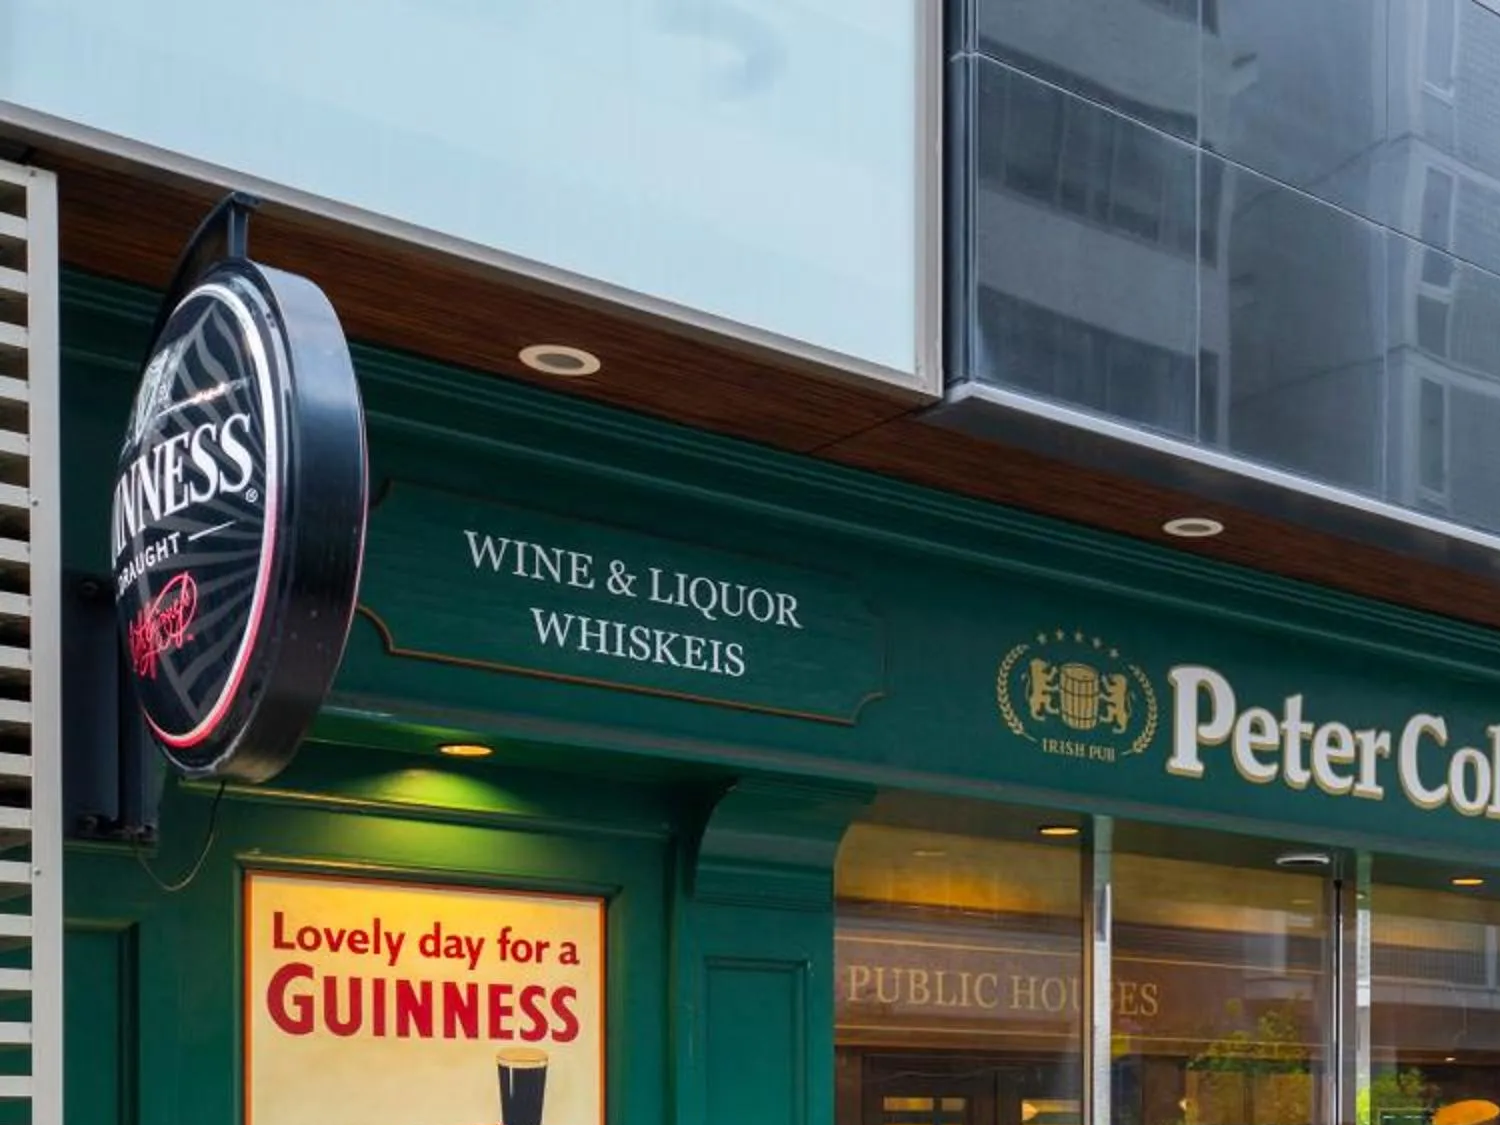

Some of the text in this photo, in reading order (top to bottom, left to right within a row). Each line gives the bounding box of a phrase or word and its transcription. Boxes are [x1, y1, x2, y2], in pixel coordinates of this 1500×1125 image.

[111, 413, 254, 569] INNESS
[463, 530, 803, 630] WINE & LIQUOR
[531, 607, 747, 678] WHISKEIS
[1042, 737, 1116, 764] IRISH PUB
[1165, 665, 1391, 800] Peter
[271, 911, 580, 971] Lovely day for a
[266, 962, 581, 1043] GUINNESS
[847, 965, 1160, 1018] PUBLIC HOES
